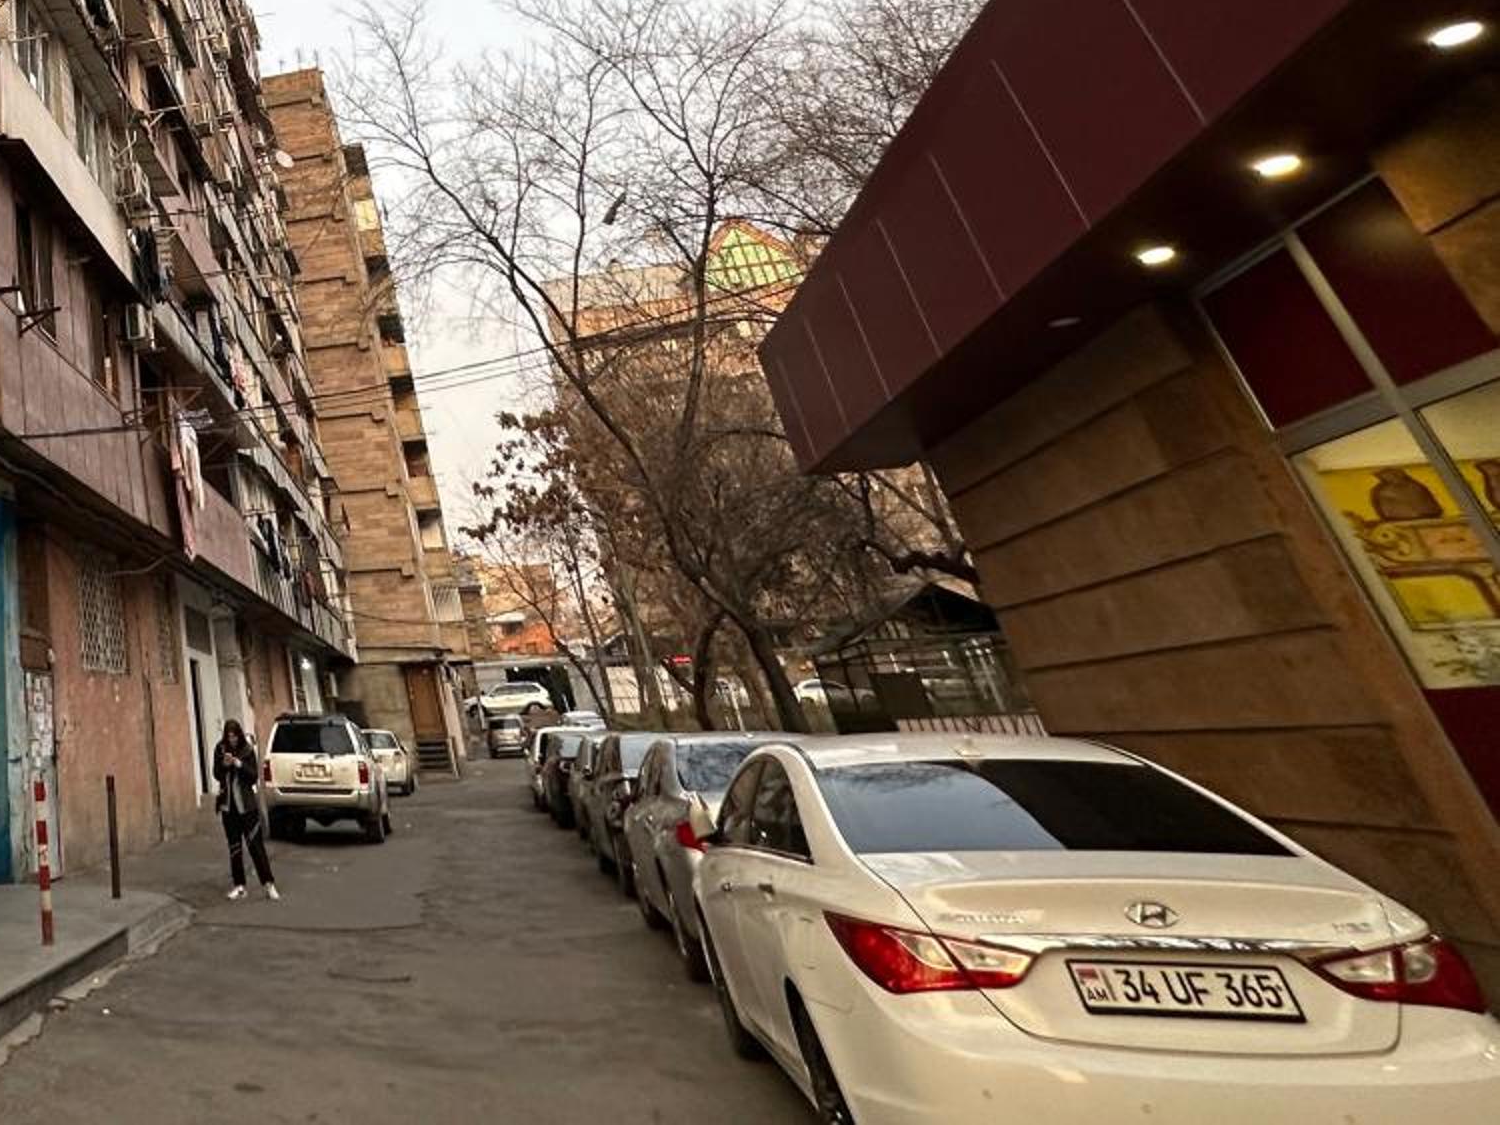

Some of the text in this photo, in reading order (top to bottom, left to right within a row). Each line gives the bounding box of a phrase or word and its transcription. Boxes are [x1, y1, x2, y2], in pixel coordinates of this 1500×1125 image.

[1086, 985, 1109, 1001] AM
[1113, 968, 1284, 1008] 34 UF 365
